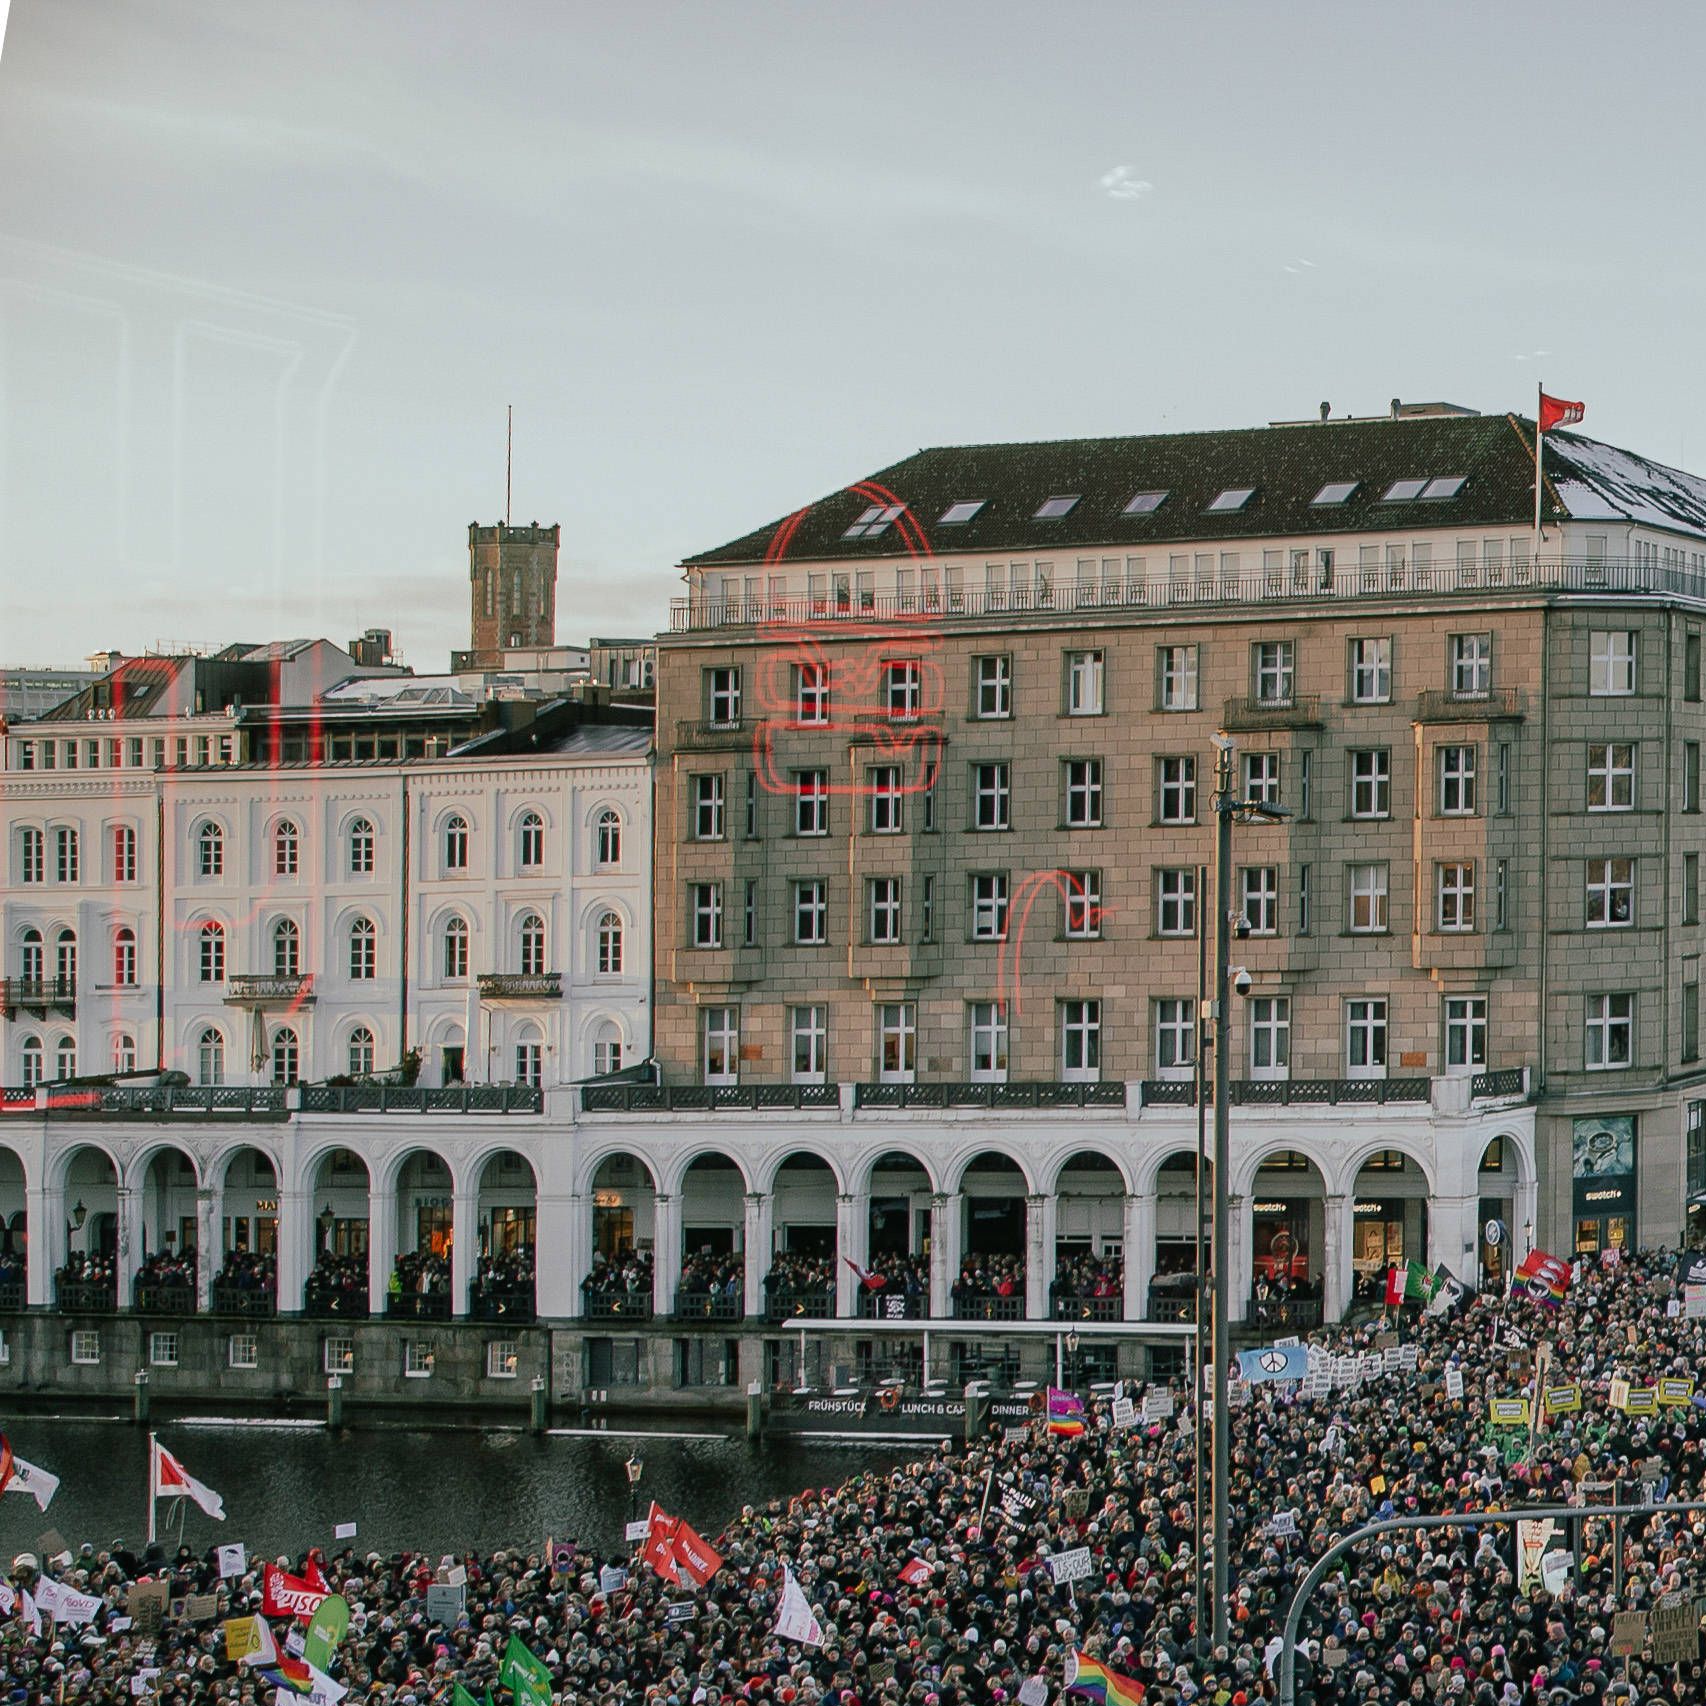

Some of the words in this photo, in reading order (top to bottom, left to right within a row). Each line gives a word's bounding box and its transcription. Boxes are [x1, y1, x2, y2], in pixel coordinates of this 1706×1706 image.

[808, 1399, 866, 1412] FRÜHSTÜCK
[902, 1404, 935, 1414] LUNCH
[936, 1404, 945, 1414] &
[946, 1404, 966, 1414] CAF
[992, 1405, 1029, 1416] DINNER
